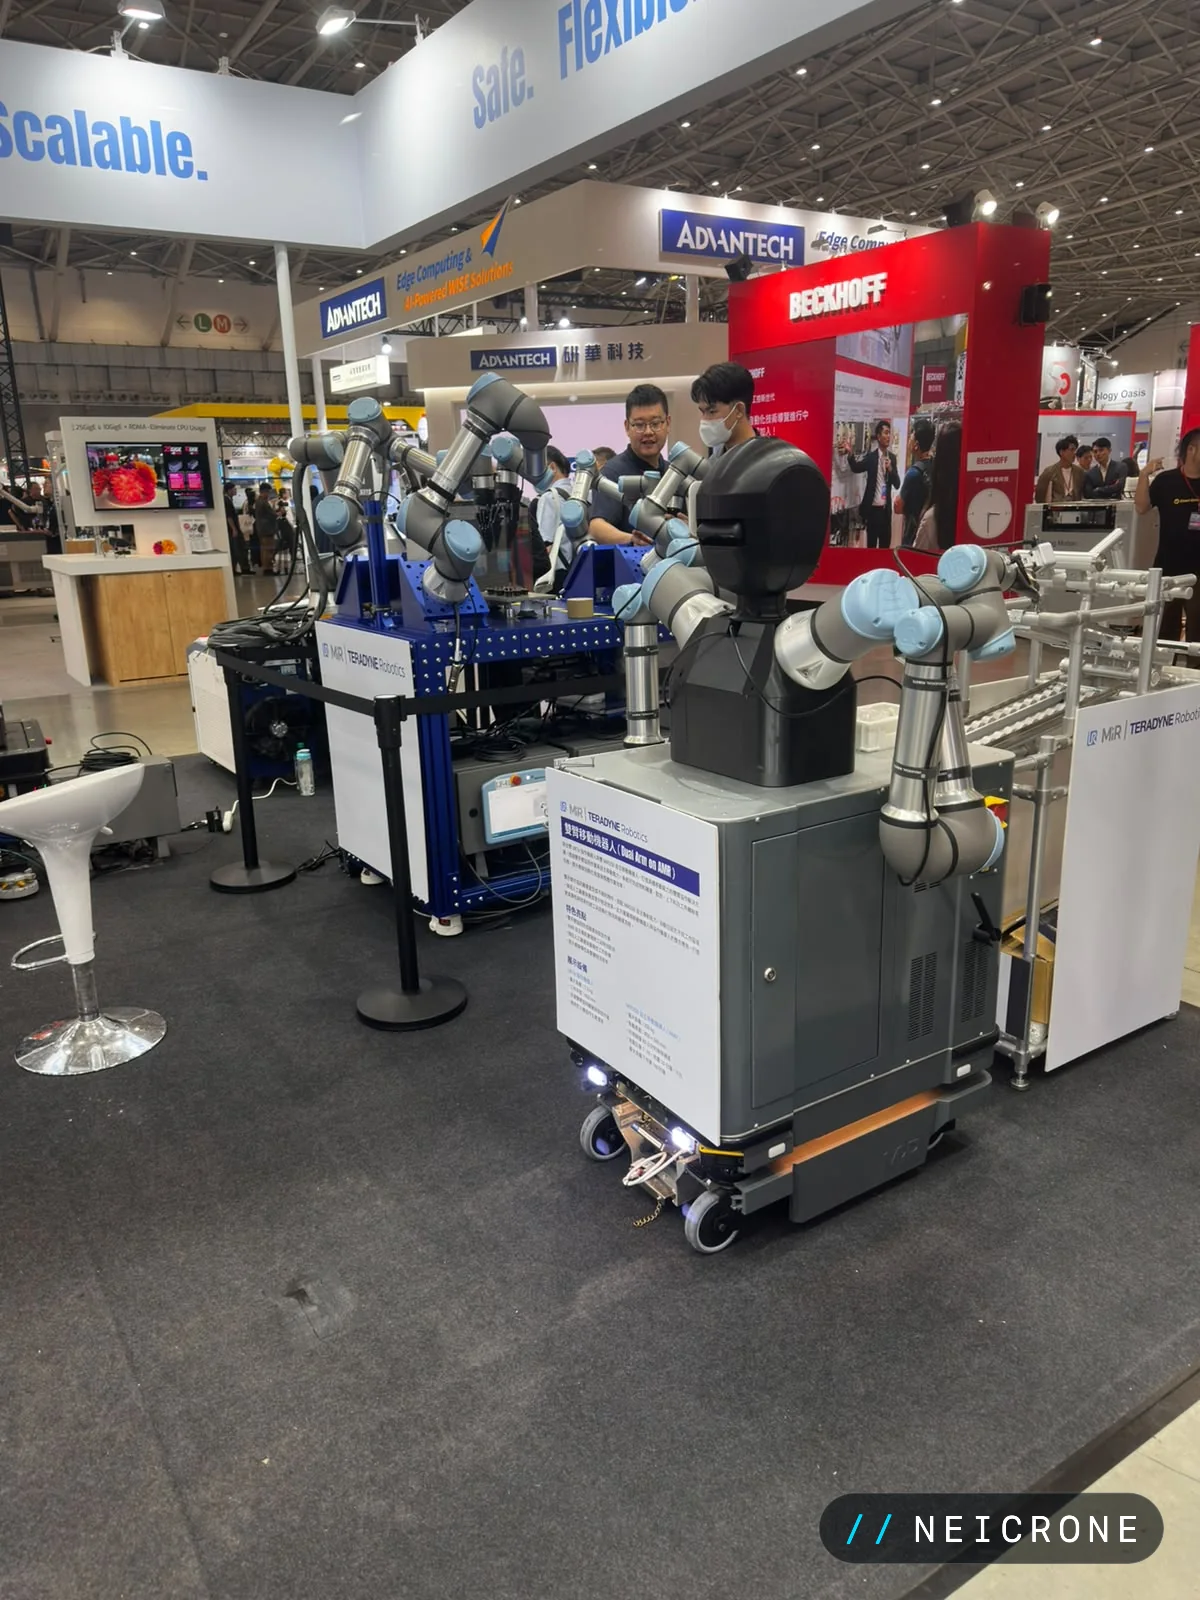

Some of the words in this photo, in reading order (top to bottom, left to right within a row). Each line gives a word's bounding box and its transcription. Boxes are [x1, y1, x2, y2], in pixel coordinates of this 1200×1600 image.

[472, 46, 534, 129] Safe.
[0, 101, 208, 180] Scalable.
[676, 219, 794, 260] ADVANTECH
[818, 231, 848, 250] Edge
[850, 235, 888, 249] Com
[397, 269, 415, 292] Edge
[416, 250, 464, 283] Computing
[465, 247, 472, 264] &
[447, 273, 470, 297] WISE
[470, 261, 513, 287] Solutions
[327, 291, 381, 333] ADVANTECH
[789, 272, 888, 320] BECKHOFF
[198, 316, 208, 330] L
[217, 317, 228, 331] M
[479, 353, 550, 368] ADVANTECH
[563, 342, 645, 363] 研華科技
[1121, 389, 1146, 398] Oasis
[976, 456, 1008, 465] BECKHOFF
[330, 645, 344, 662] MiR
[347, 649, 380, 671] TERADYNE
[380, 658, 406, 678] Robotics
[1101, 725, 1122, 744] MiR
[1130, 713, 1175, 735] TERADYNE
[569, 803, 584, 819] MiR
[588, 811, 621, 832] TERADYNE
[620, 823, 649, 844] Robotics
[635, 851, 648, 867] Arm
[648, 858, 657, 871] on
